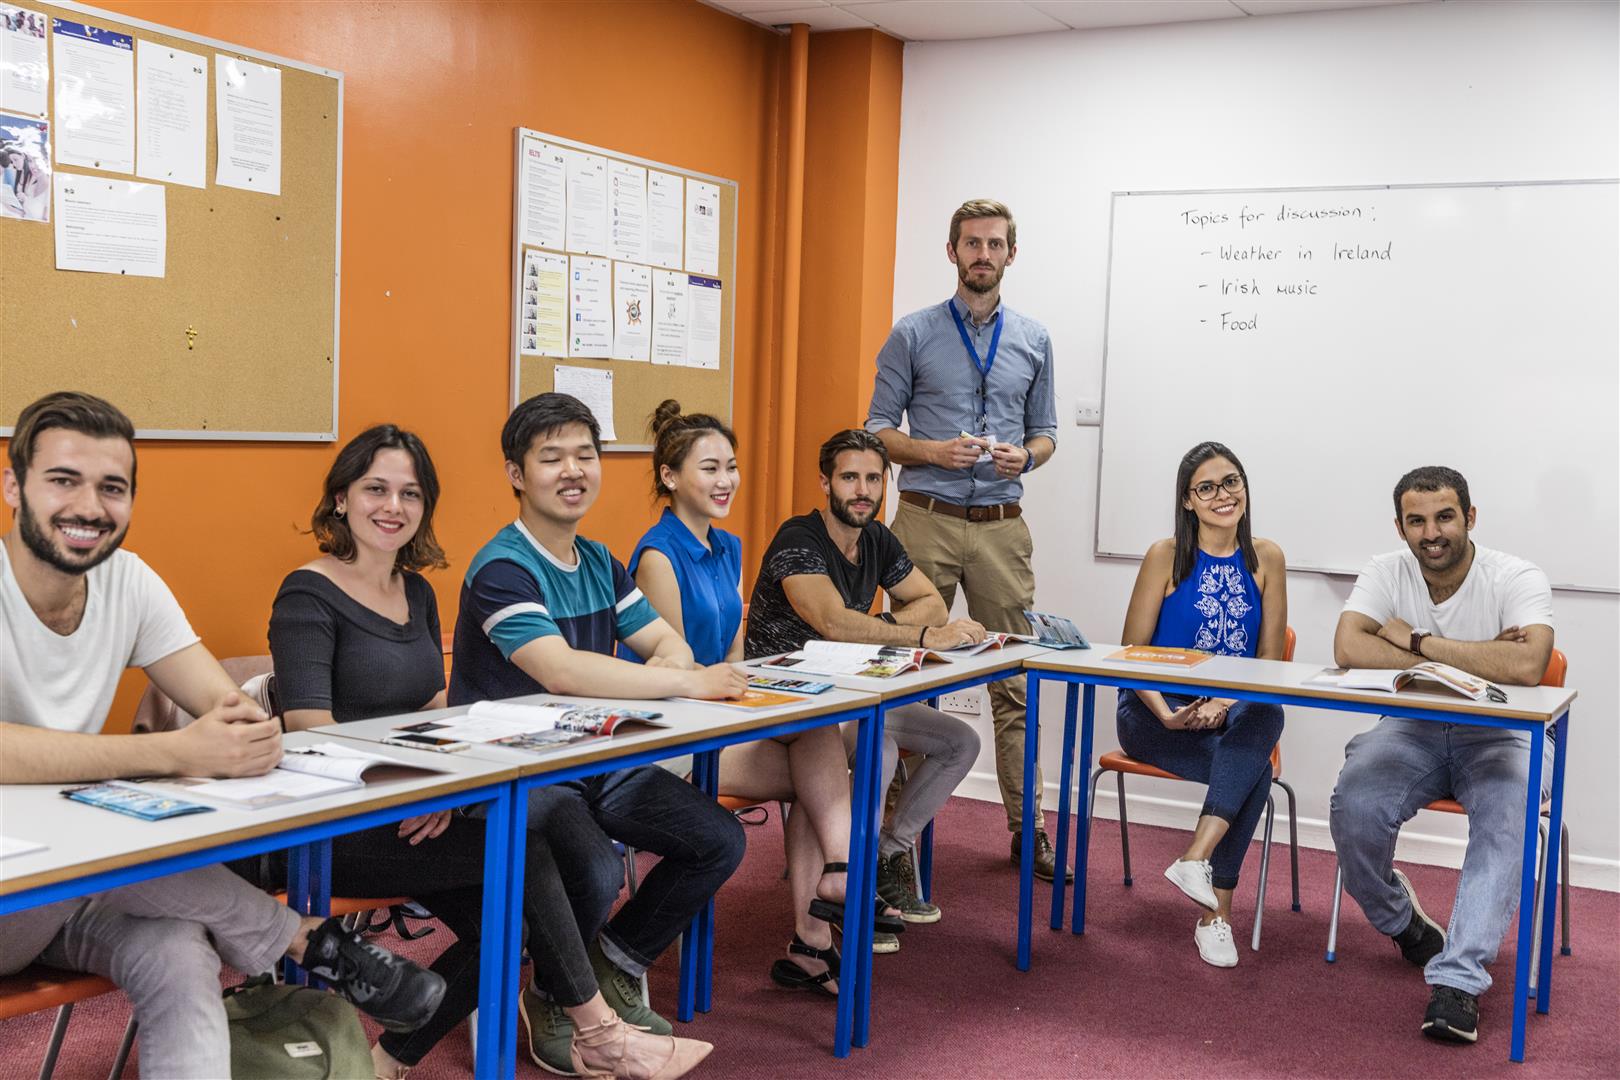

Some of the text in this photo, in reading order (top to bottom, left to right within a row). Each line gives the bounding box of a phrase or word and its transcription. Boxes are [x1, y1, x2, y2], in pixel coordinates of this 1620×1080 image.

[1181, 209, 1229, 230] Topics
[1239, 206, 1265, 229] for
[1220, 244, 1282, 261] Weather
[1298, 245, 1313, 261] in
[1333, 241, 1393, 262] Ireland
[1221, 278, 1262, 296] Irish
[1276, 280, 1319, 296] music
[1220, 311, 1259, 331] Food
